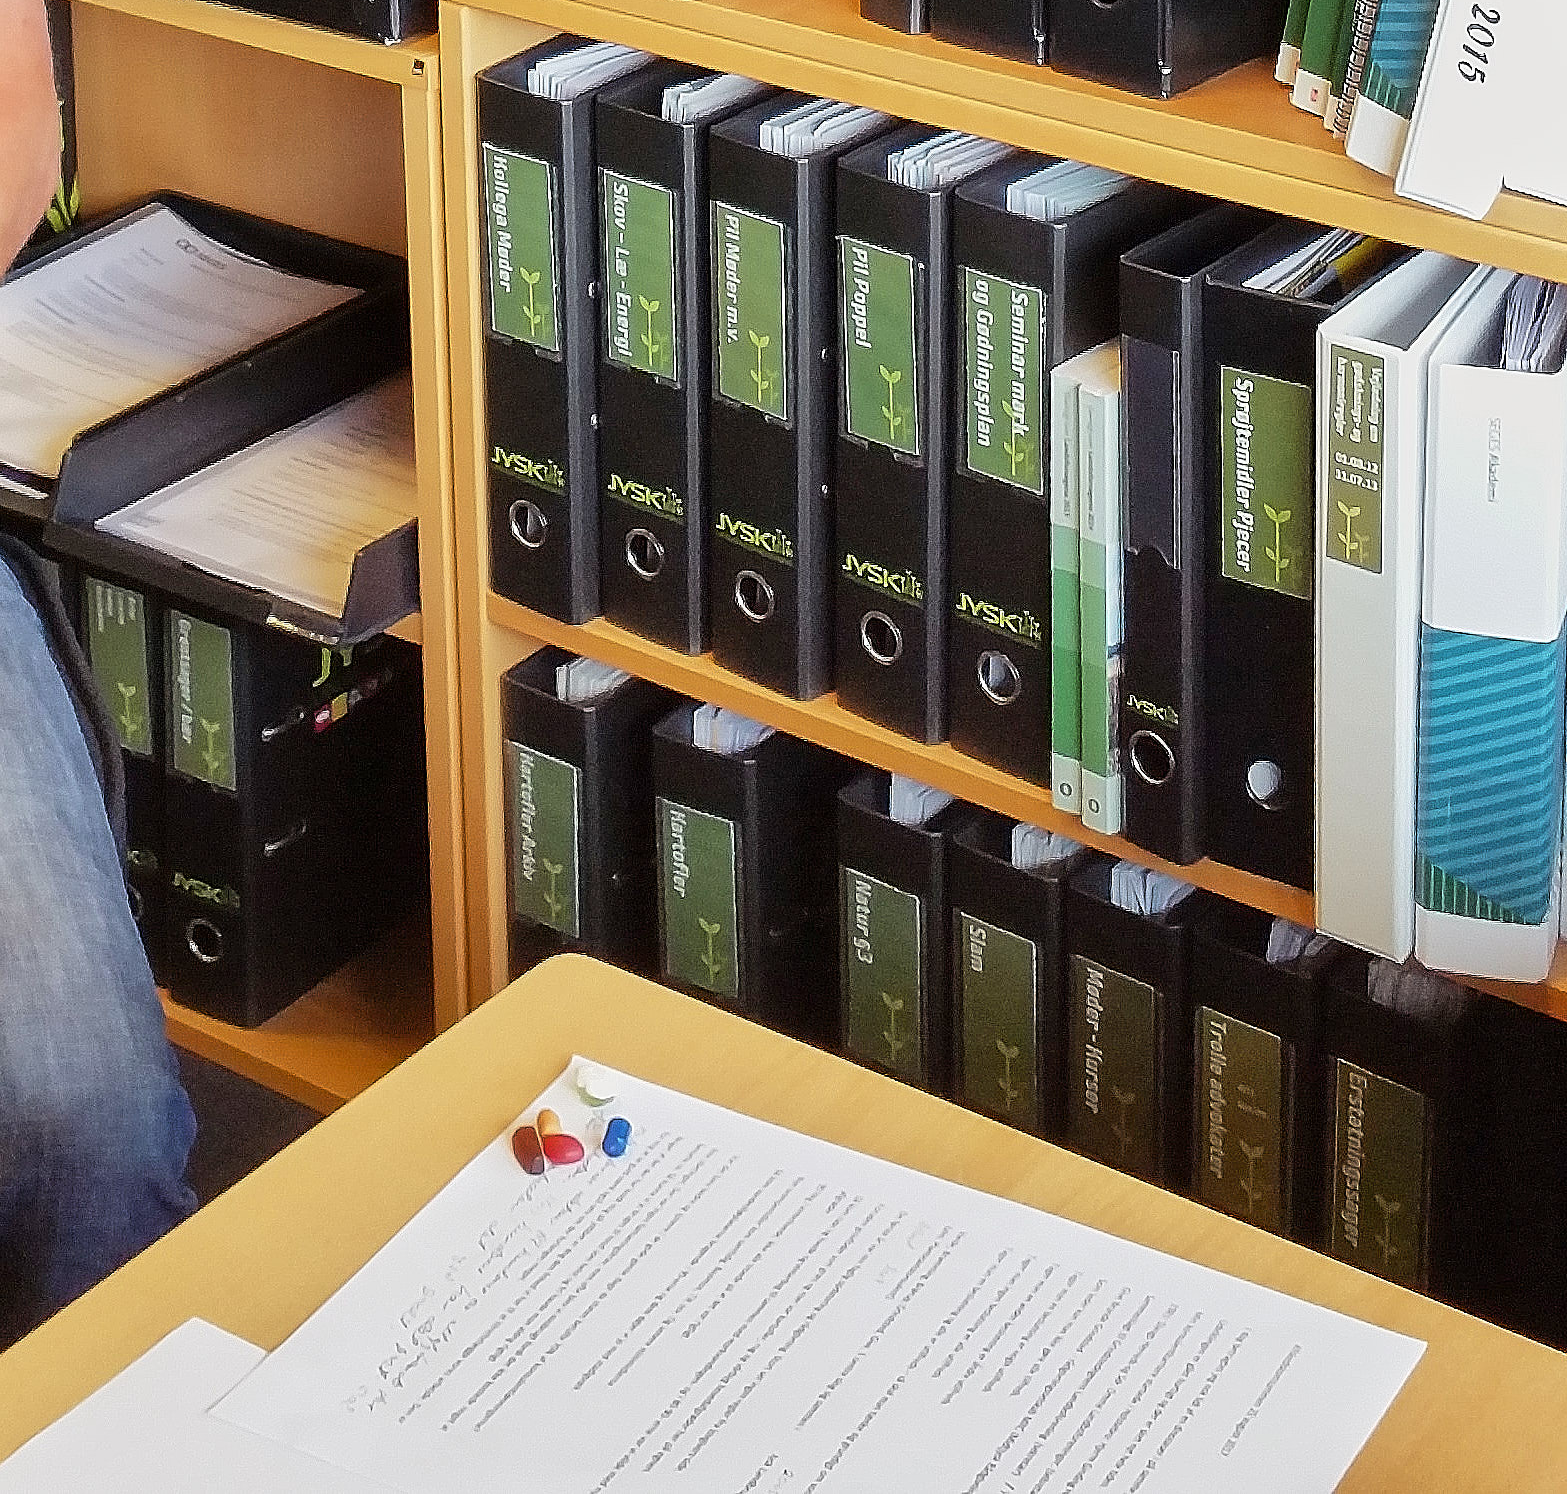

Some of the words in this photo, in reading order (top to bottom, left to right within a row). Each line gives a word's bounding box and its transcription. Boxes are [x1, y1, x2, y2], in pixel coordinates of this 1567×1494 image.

[1458, 4, 1502, 84] 2015
[492, 156, 509, 226] Kollega
[613, 182, 629, 230] Skov
[725, 215, 739, 242] Pil
[497, 231, 513, 293] Møder
[615, 247, 629, 277] Læ
[725, 243, 740, 304] Møder
[852, 247, 869, 275] Pil
[850, 277, 872, 349] Poppel
[972, 279, 990, 305] og
[613, 292, 632, 357] Energi
[1011, 289, 1029, 378] Seminar
[973, 309, 995, 447] Gødningsplan
[492, 446, 544, 481] JYSK
[1232, 377, 1254, 509] Sprøjtemidler
[608, 473, 662, 510] JYSK
[715, 512, 773, 551] JYSK
[1232, 510, 1254, 572] Pjecer
[842, 554, 901, 594] JYSK
[955, 593, 1018, 633] JYSK
[1127, 694, 1164, 720] JYSK
[670, 810, 689, 898] Kartofler
[856, 880, 872, 938] Natur
[969, 925, 986, 972] Slam
